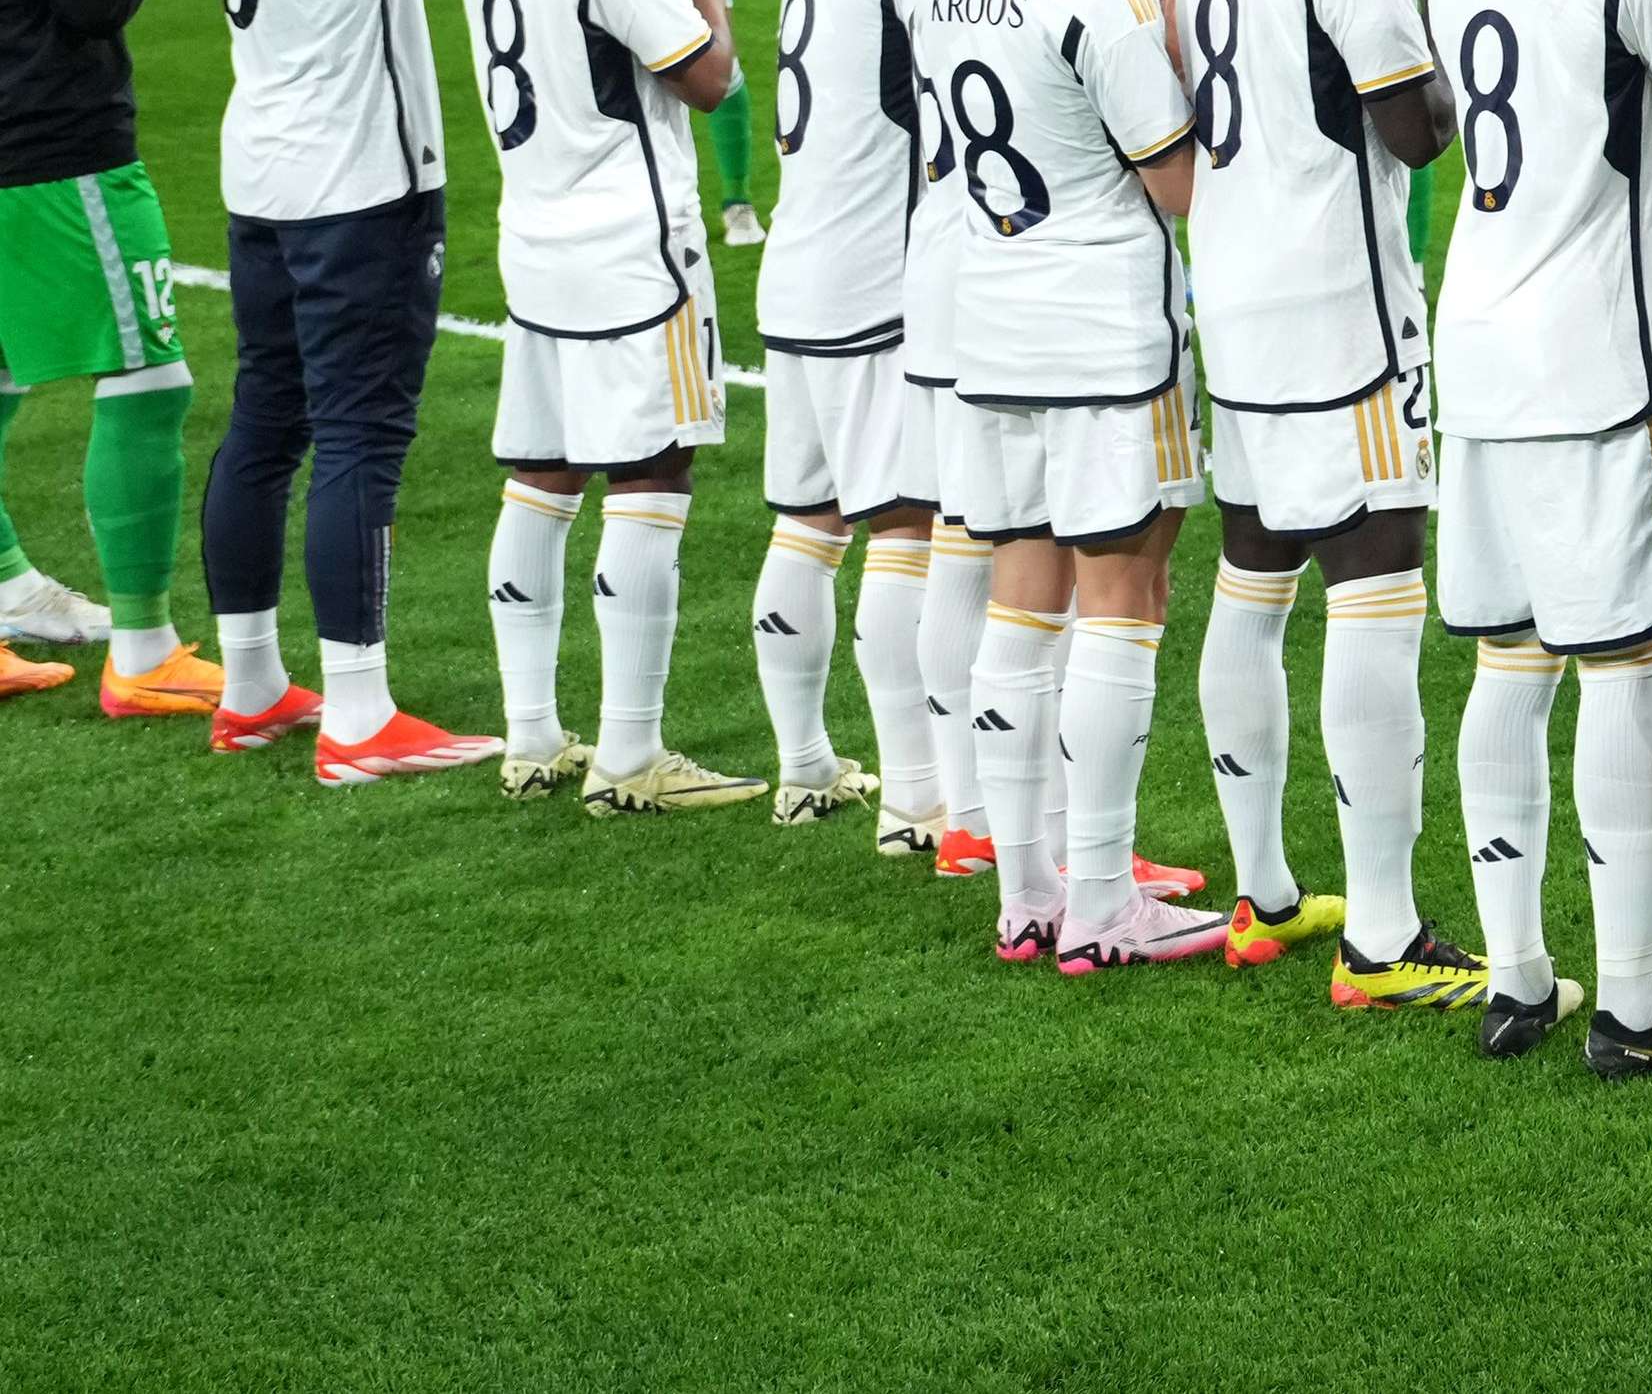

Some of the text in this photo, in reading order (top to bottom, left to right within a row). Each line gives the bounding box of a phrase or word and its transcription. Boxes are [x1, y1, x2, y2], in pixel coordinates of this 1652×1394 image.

[950, 58, 1052, 238] 8
[1460, 8, 1523, 213] 8
[132, 257, 176, 320] 12
